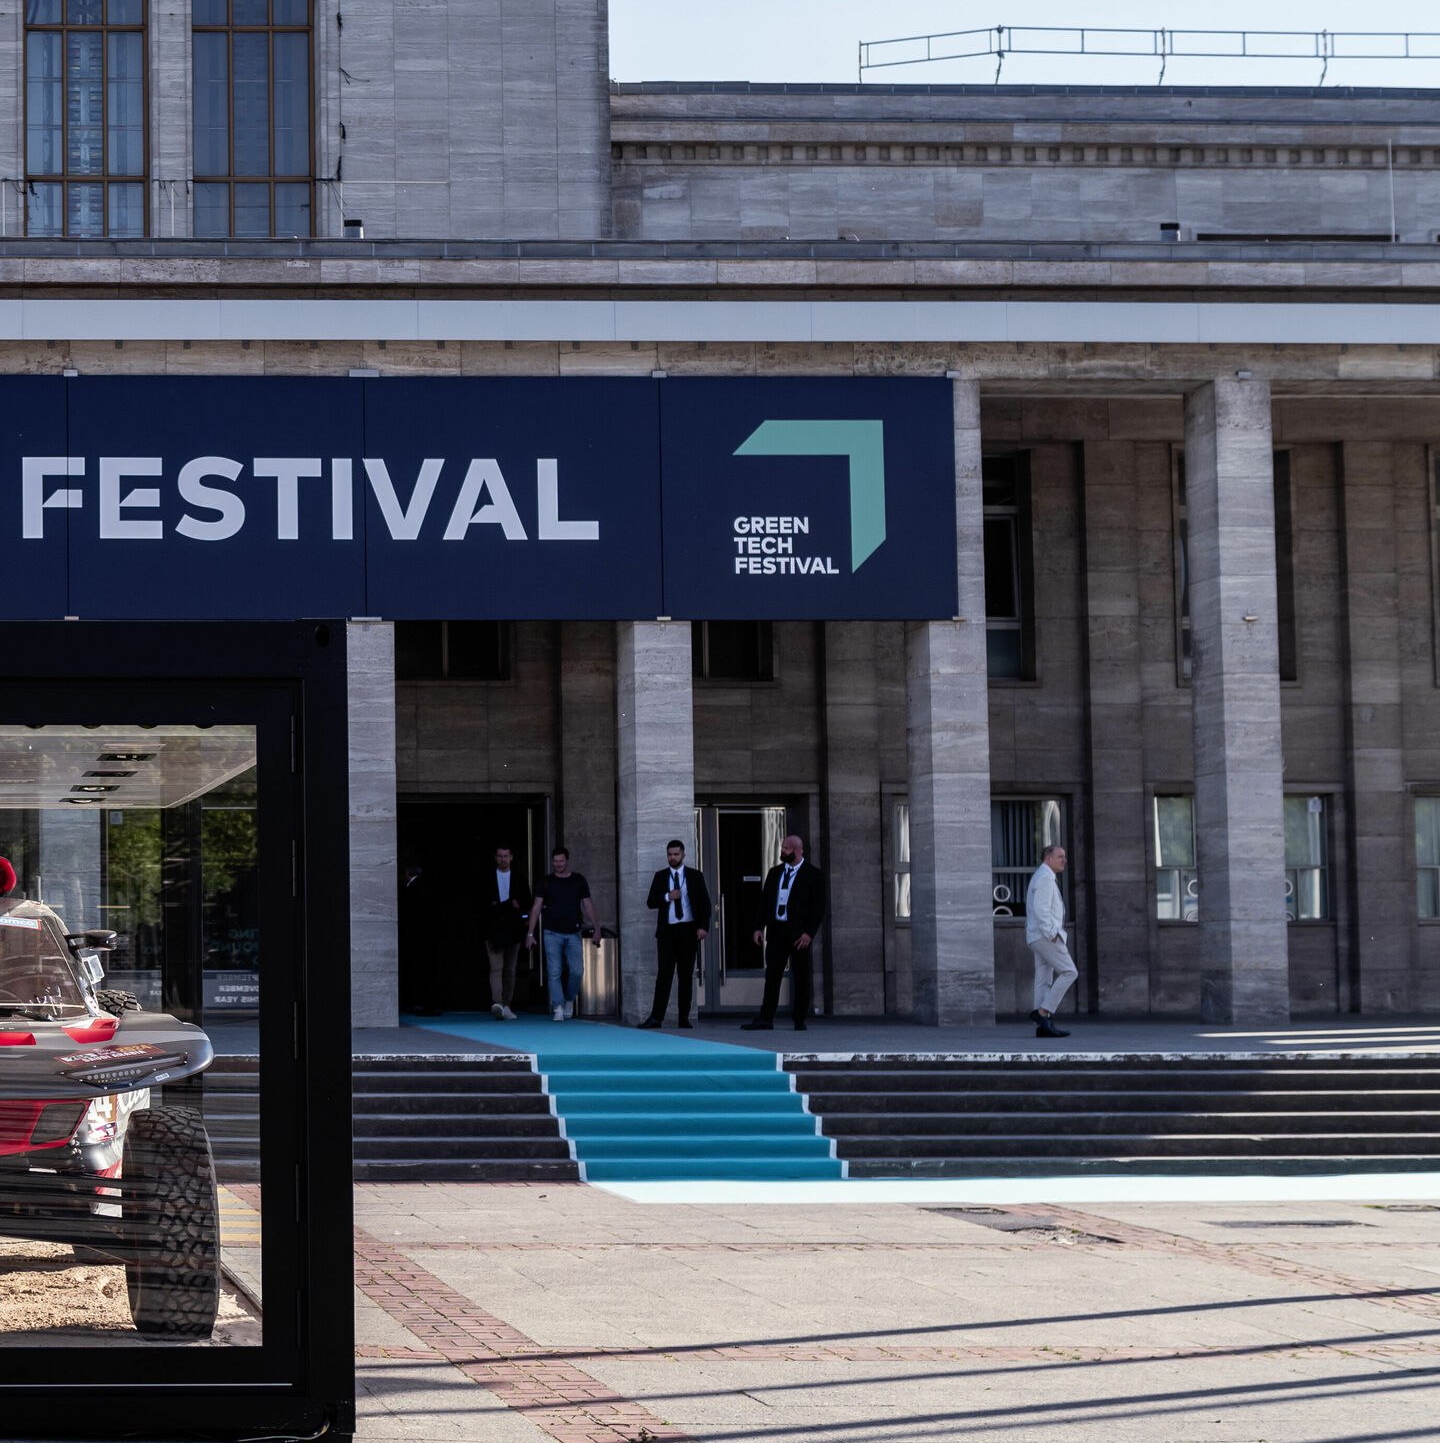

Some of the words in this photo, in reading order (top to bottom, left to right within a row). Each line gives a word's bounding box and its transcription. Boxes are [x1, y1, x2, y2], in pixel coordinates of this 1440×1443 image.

[23, 457, 600, 541] FESTIVAL
[733, 516, 810, 534] GREEN
[734, 537, 793, 554] TECH
[735, 557, 840, 575] FESTIVAL
